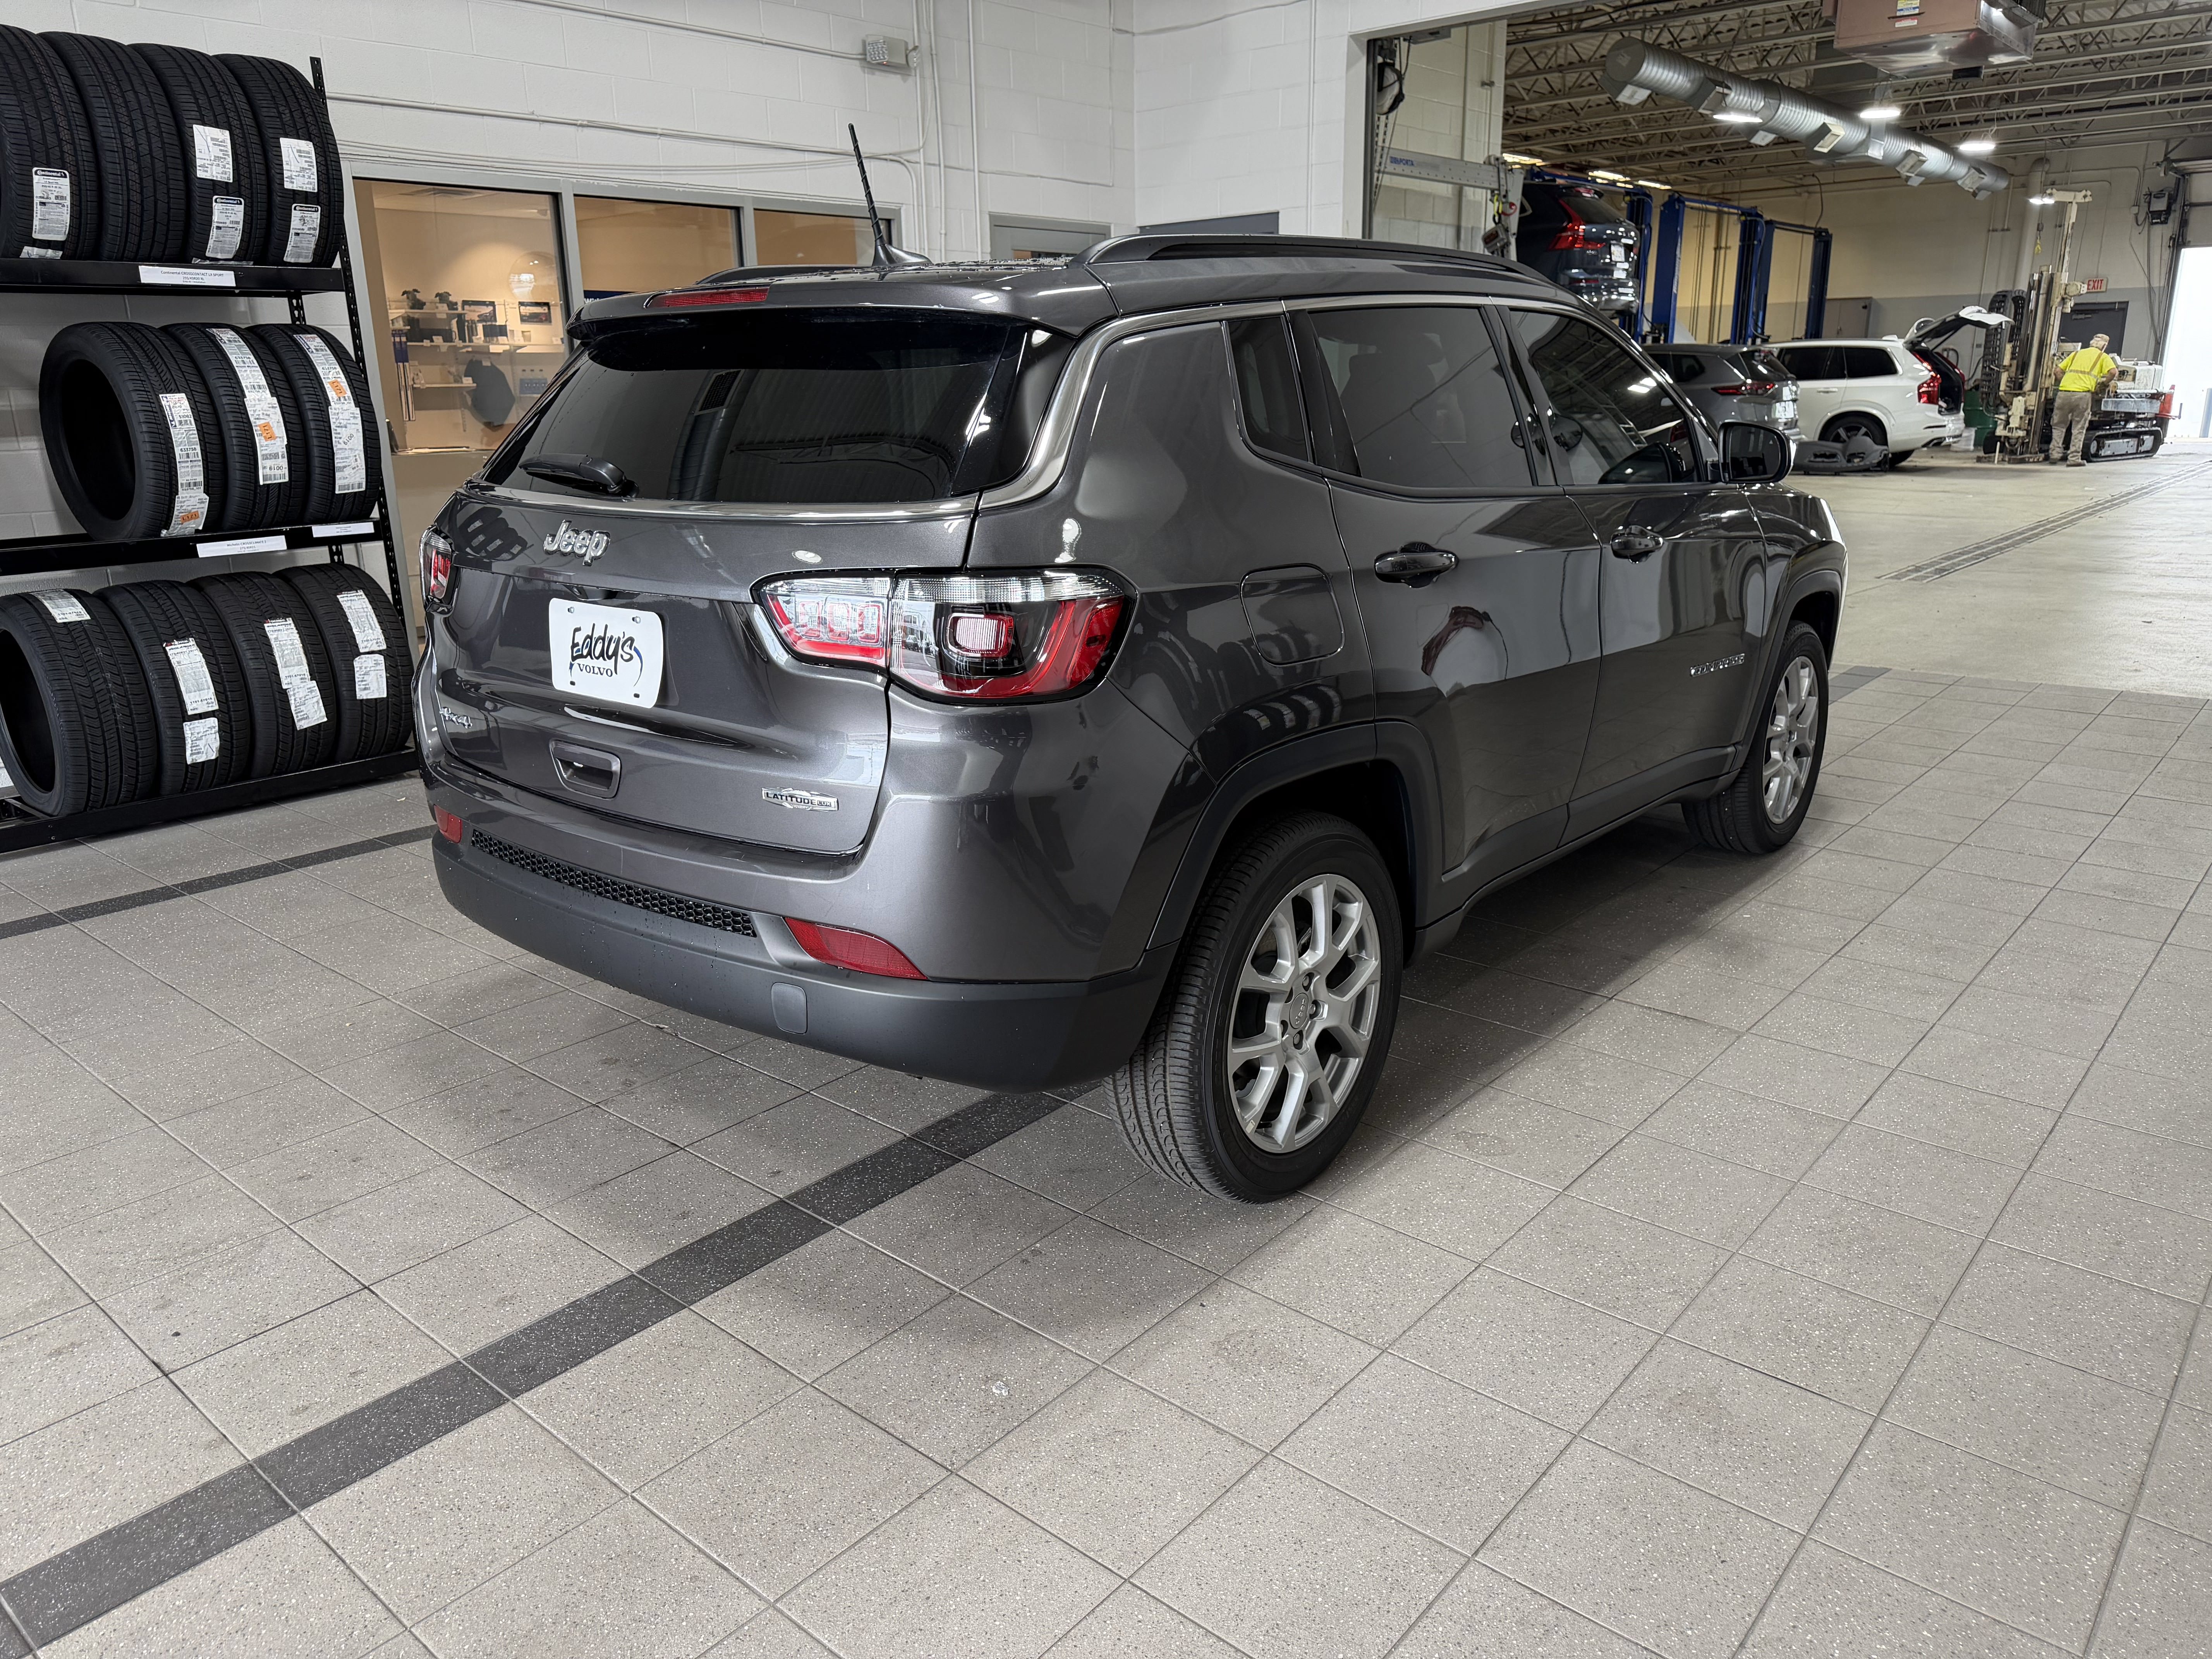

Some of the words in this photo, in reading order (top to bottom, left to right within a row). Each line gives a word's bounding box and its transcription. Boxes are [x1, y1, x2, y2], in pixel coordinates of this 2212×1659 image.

[2087, 279, 2104, 290] EXIT
[543, 519, 611, 567] Jeep
[570, 623, 635, 675] Eddy's
[577, 663, 613, 677] VOLVO
[1690, 653, 1745, 677] COMPASS
[766, 792, 817, 805] LATITUDE
